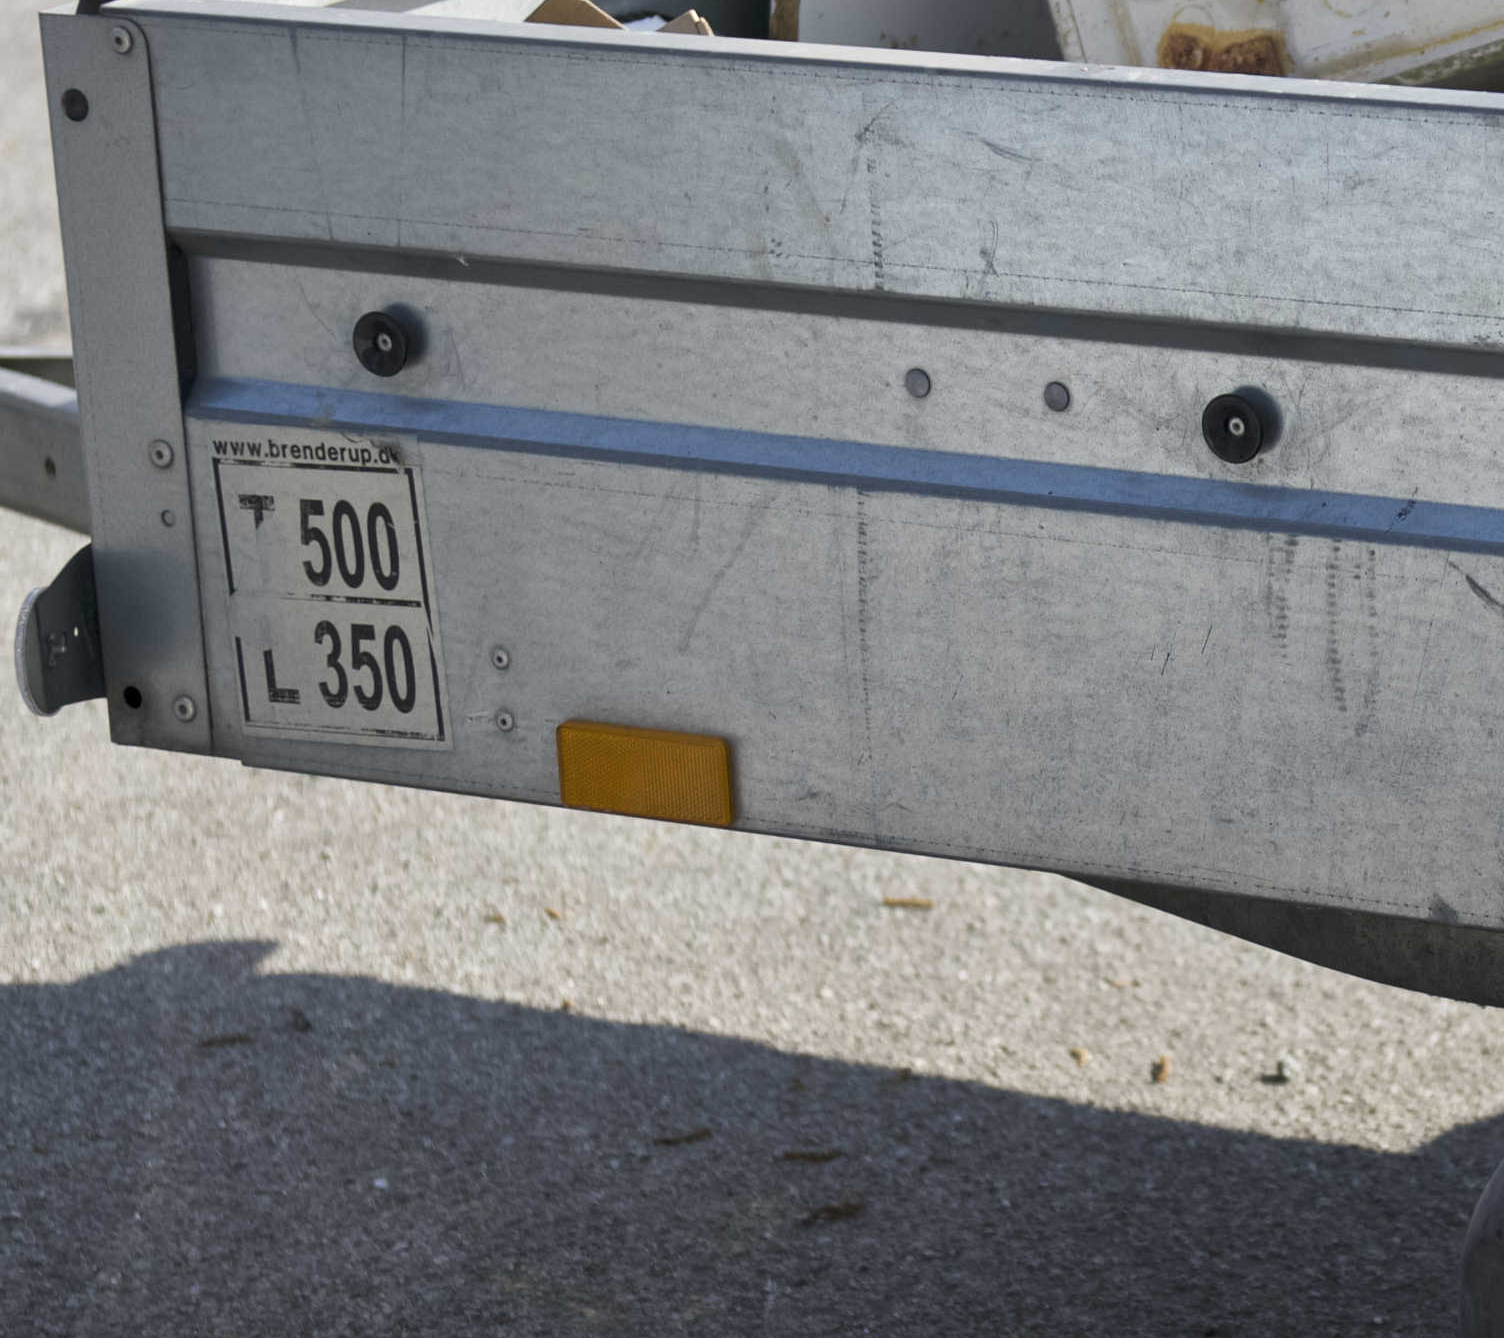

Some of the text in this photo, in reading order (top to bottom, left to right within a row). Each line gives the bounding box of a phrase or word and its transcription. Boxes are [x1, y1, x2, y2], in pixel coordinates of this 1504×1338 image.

[212, 438, 401, 465] www.brenderup.dk
[299, 498, 400, 591] 500
[263, 619, 416, 714] L 350
